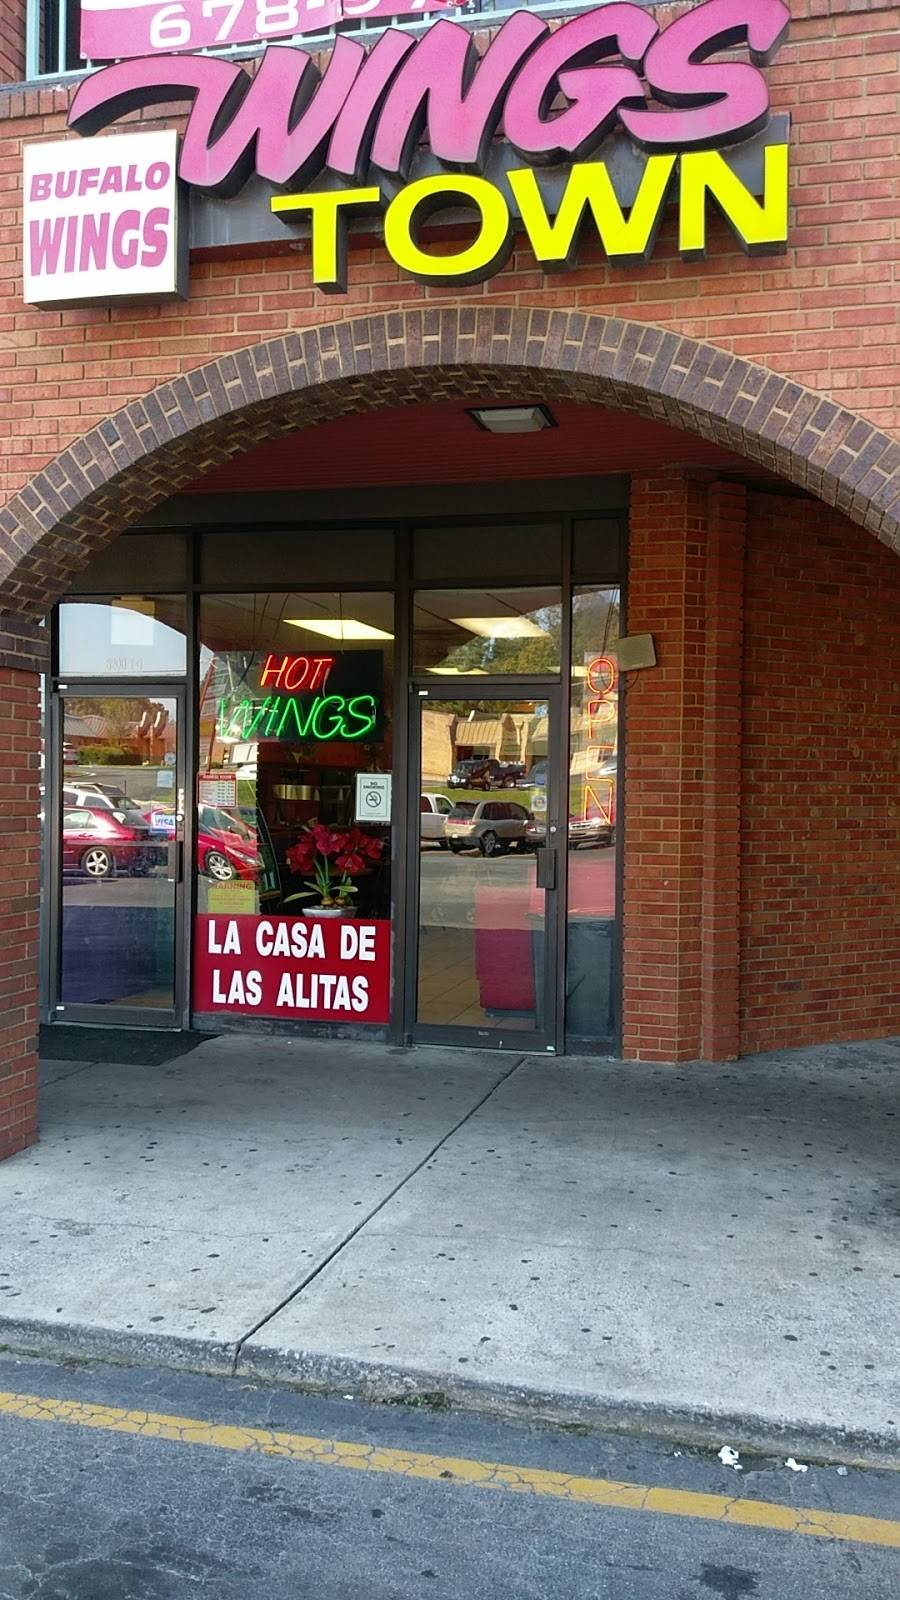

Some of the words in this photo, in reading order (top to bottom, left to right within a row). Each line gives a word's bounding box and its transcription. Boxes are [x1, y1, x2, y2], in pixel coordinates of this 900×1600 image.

[68, 0, 790, 187] WINGS
[29, 161, 170, 202] BUFALO
[271, 144, 789, 284] TOWN
[29, 207, 170, 277] WINGS
[260, 655, 334, 690] HOT
[217, 695, 377, 739] WINGS
[583, 656, 616, 825] OPEN
[208, 920, 241, 954] LA
[256, 920, 326, 958] CASA
[340, 925, 376, 961] DE
[212, 970, 263, 1006] LAS
[276, 973, 369, 1012] ALITAS
